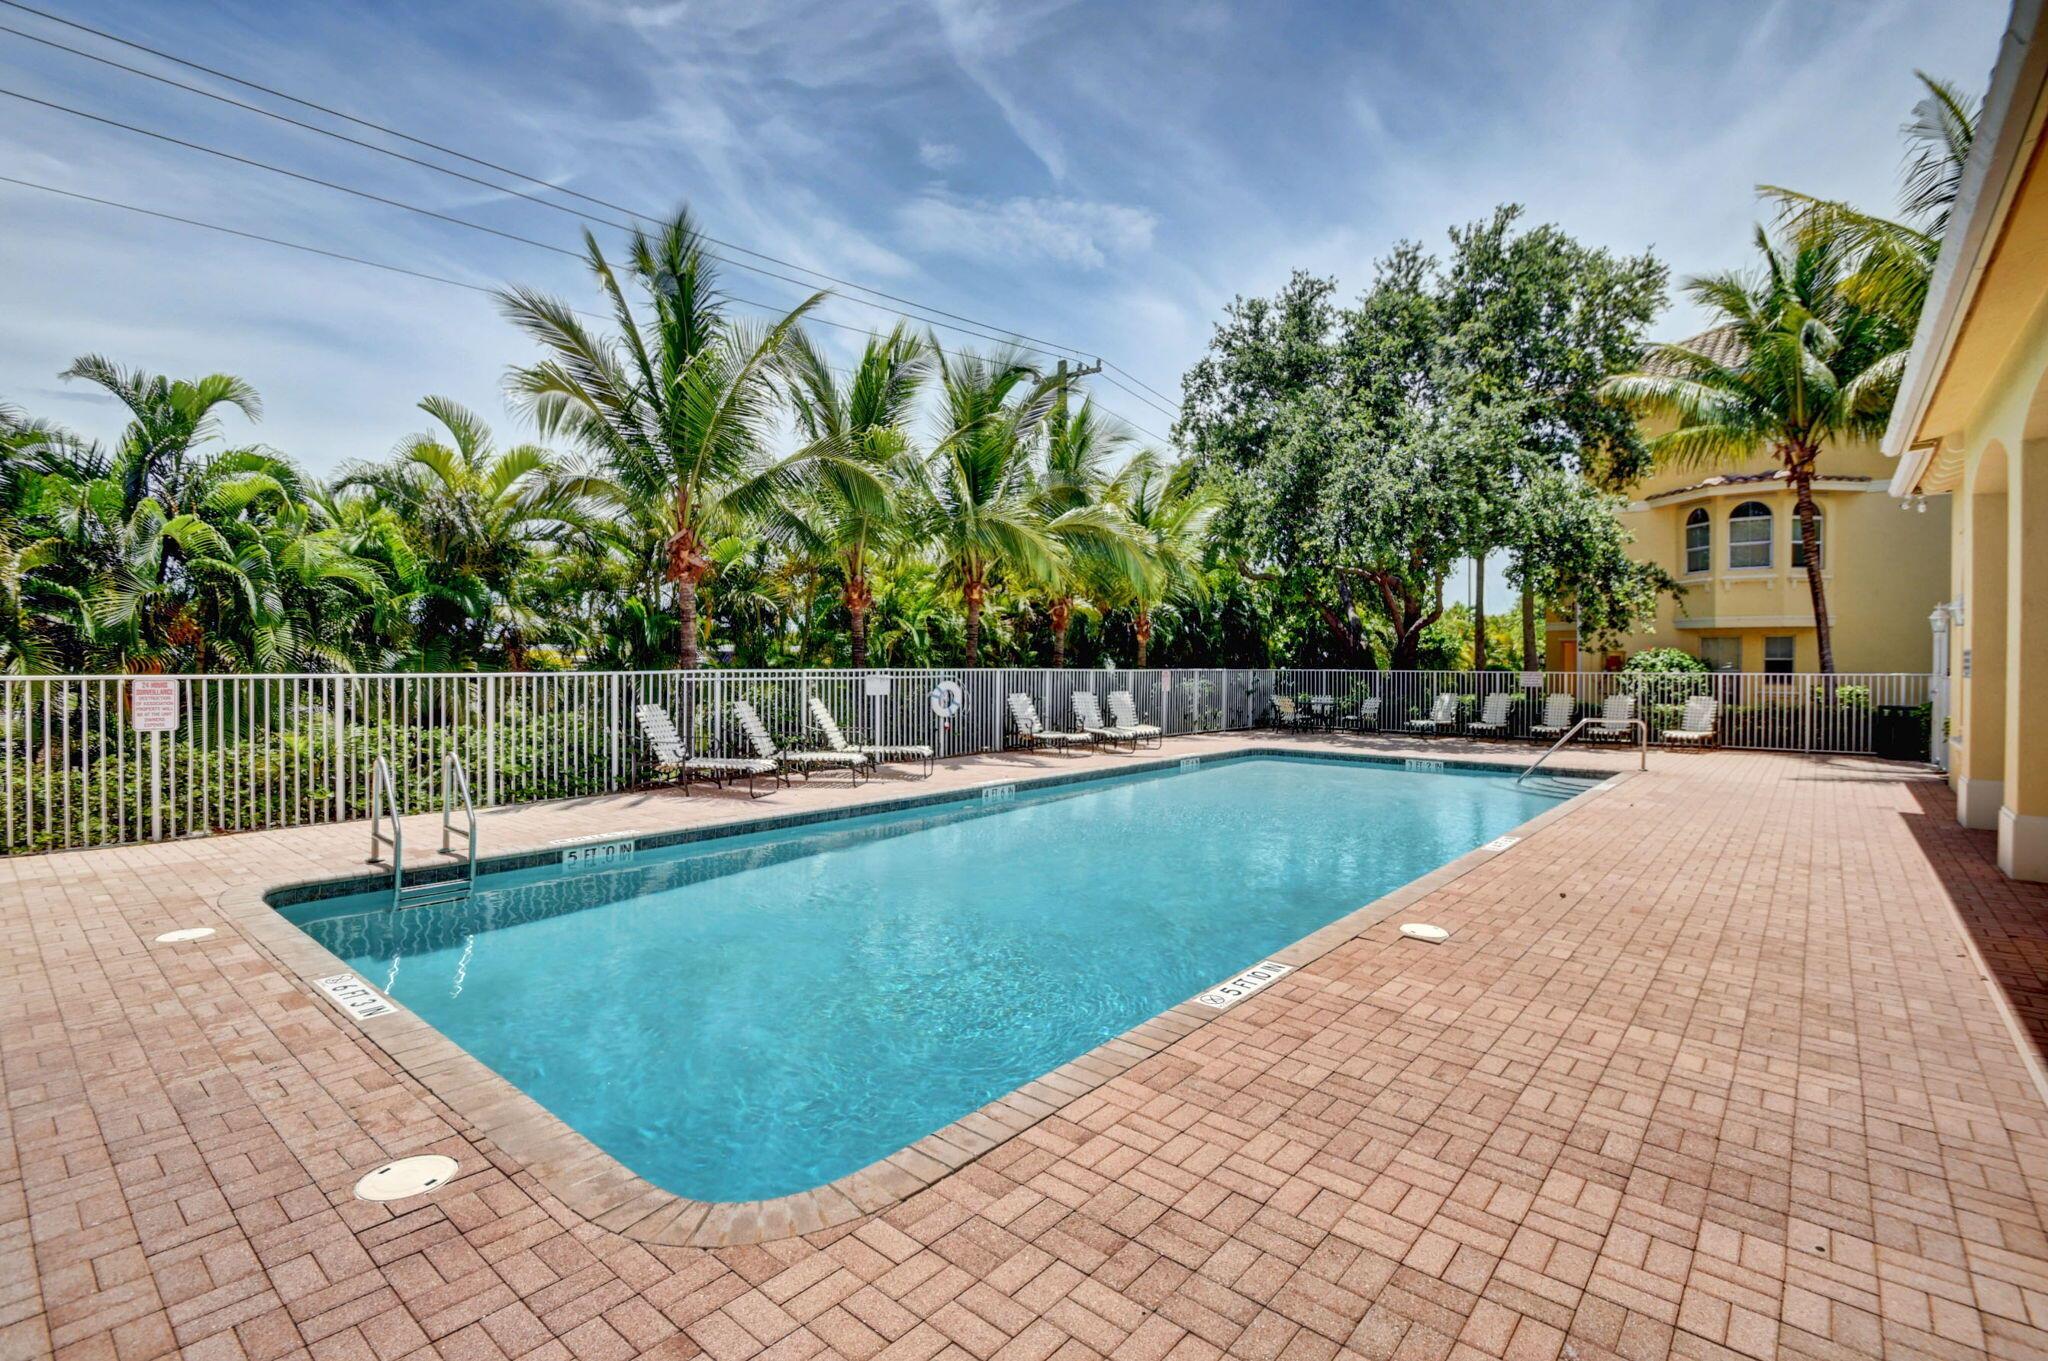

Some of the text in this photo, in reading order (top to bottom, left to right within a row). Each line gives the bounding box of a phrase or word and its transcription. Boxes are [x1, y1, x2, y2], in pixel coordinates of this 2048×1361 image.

[568, 851, 577, 861] 5
[584, 847, 597, 858] FT
[1220, 962, 1286, 996] 5 FT 10 IN
[338, 989, 370, 1000] FT
[350, 999, 377, 1007] 3
[357, 1005, 391, 1017] IN
